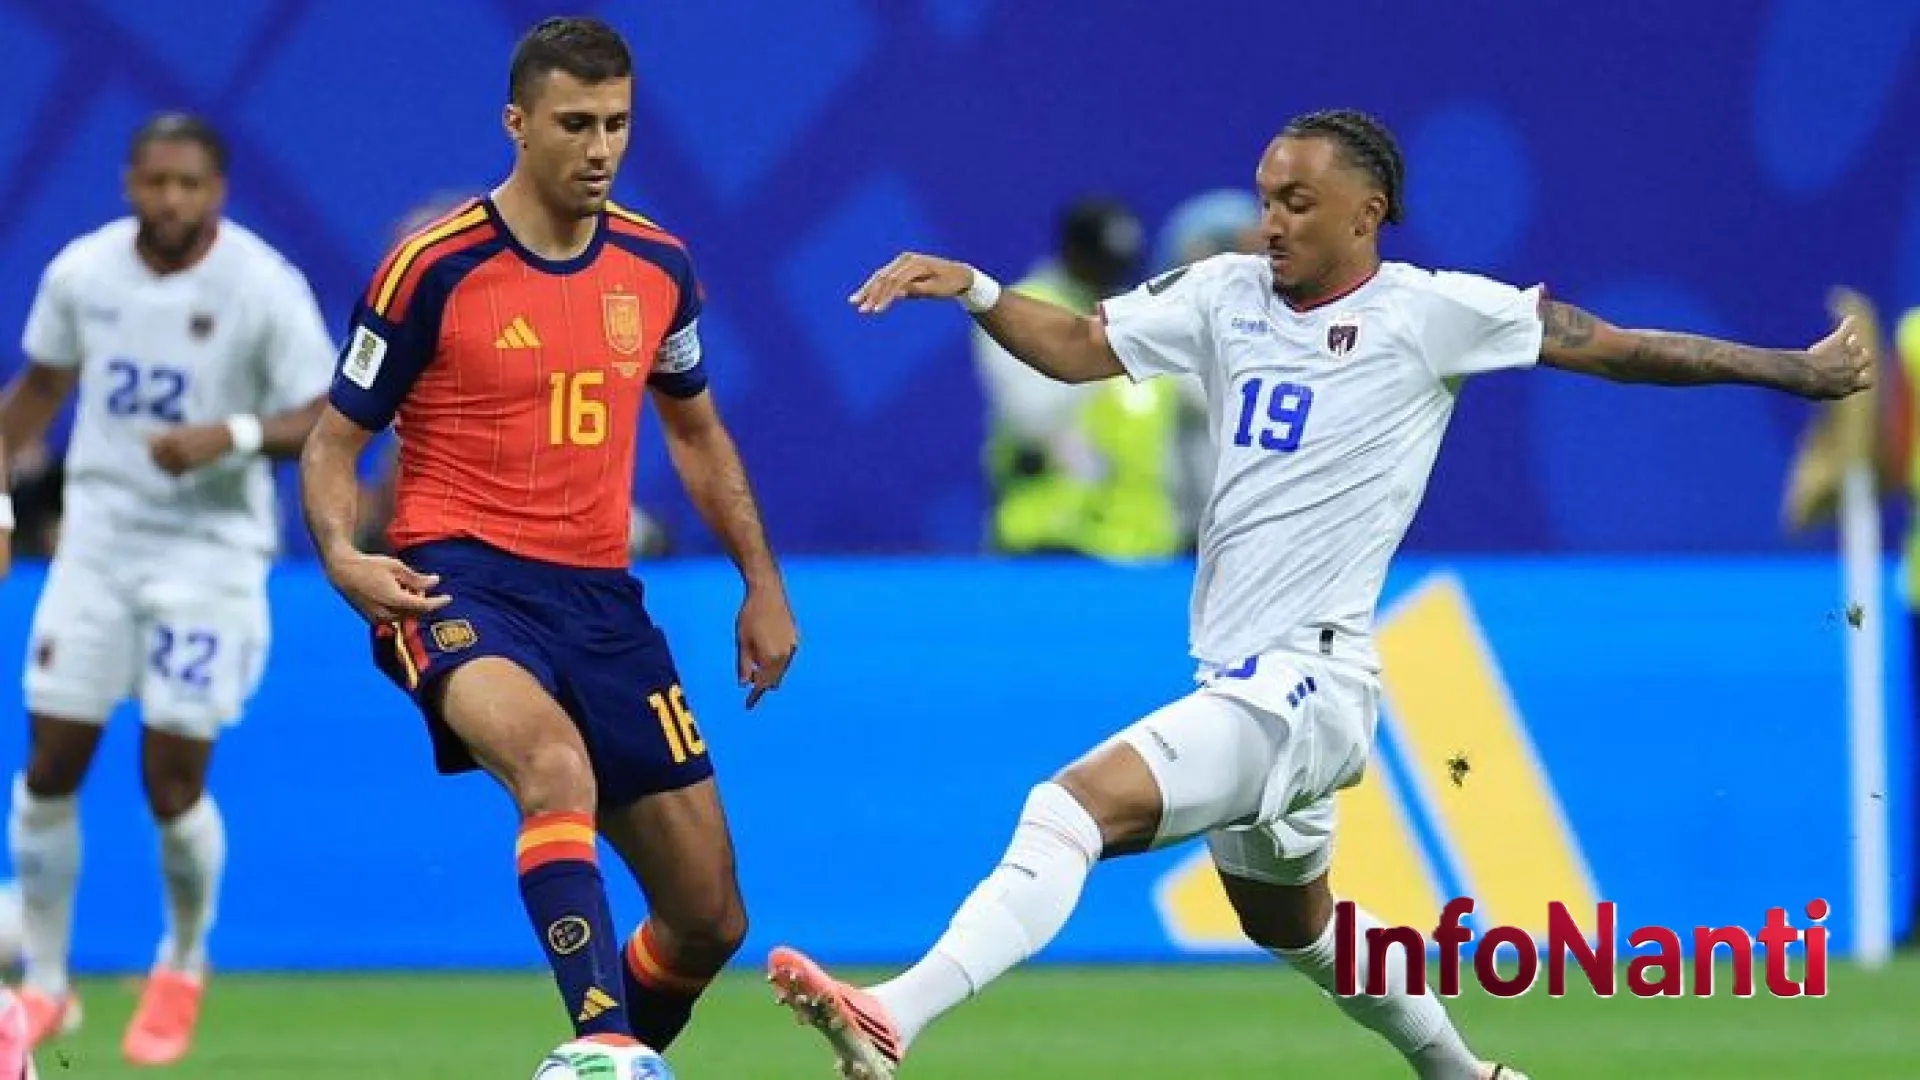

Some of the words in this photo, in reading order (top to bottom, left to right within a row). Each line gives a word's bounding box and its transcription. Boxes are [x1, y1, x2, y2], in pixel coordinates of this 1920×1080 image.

[105, 359, 185, 423] 22
[549, 371, 607, 445] 16
[1233, 377, 1314, 453] 19
[150, 624, 218, 687] 22
[647, 684, 707, 763] 16
